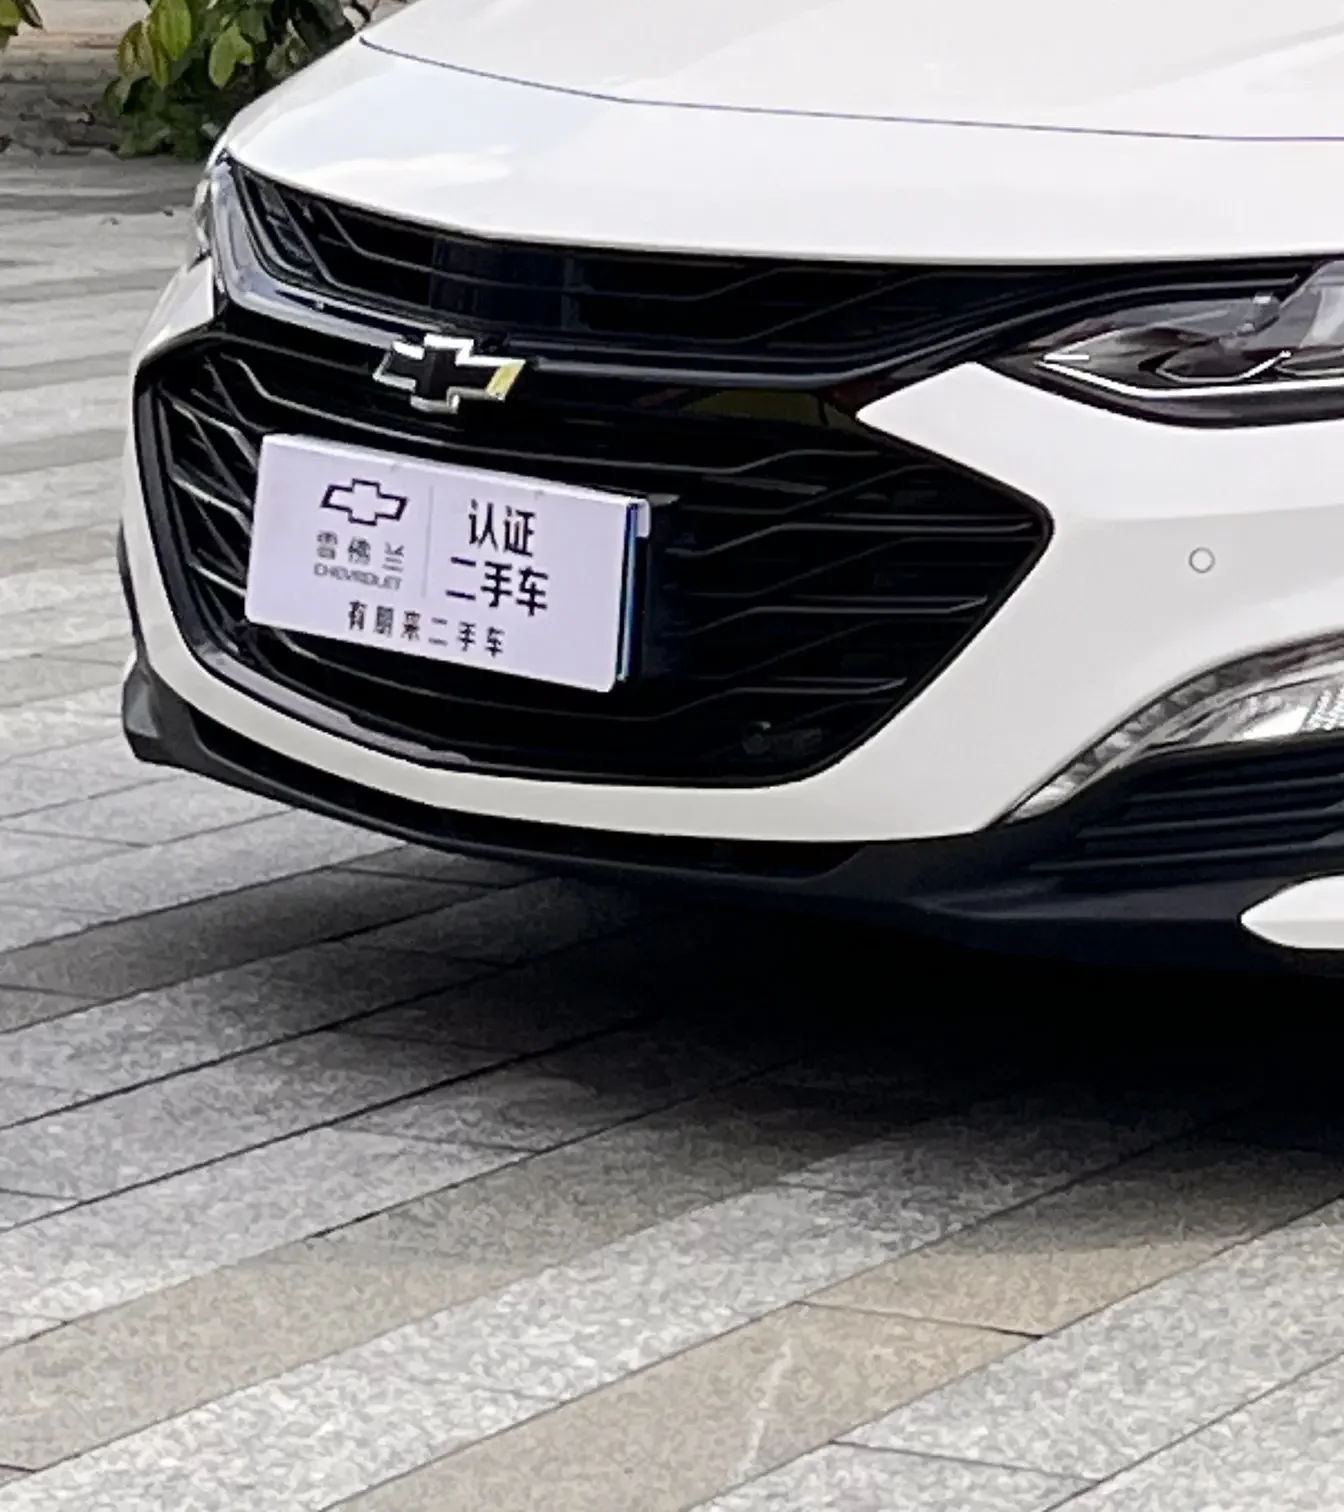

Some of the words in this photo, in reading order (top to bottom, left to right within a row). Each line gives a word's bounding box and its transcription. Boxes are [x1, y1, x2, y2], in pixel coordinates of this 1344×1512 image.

[467, 498, 536, 557] 认证
[445, 556, 548, 617] 二手车
